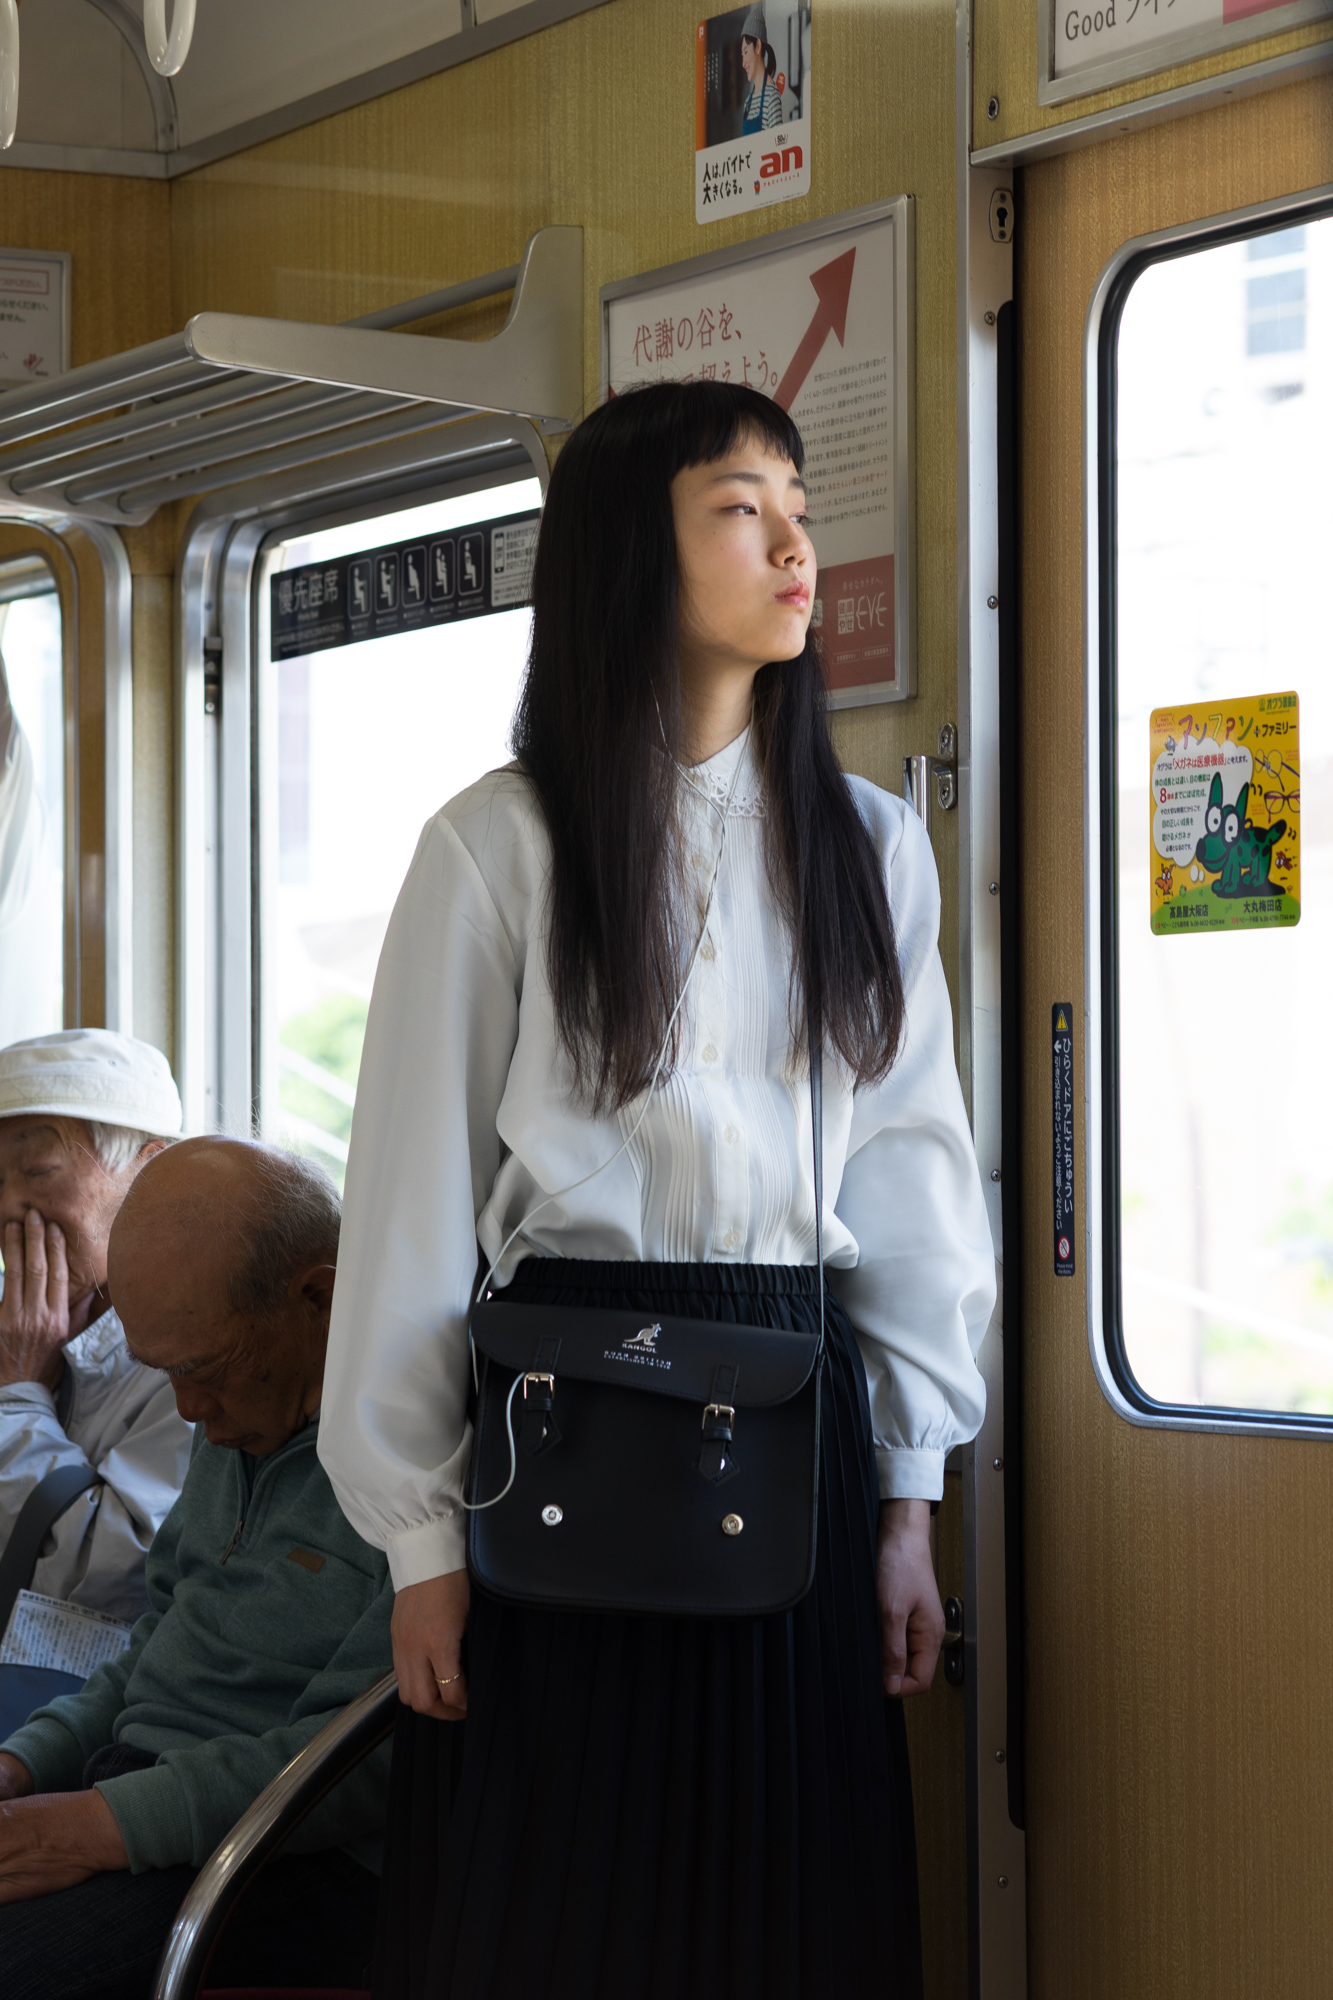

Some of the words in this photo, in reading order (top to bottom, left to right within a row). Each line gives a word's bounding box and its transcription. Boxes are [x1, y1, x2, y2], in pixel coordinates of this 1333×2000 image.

[1065, 0, 1116, 41] Good
[703, 151, 752, 183] 人は、バイトで
[759, 145, 803, 179] an
[702, 179, 743, 205] 大きくなる。
[632, 302, 742, 367] 代謝の谷を、
[278, 568, 338, 616] 優先座席
[856, 592, 888, 631] EVE
[1156, 753, 1248, 771] オグラは「メガネは医療機器」と考えます。
[1161, 817, 1194, 829] 目の正しい成長を
[1243, 898, 1283, 914] 大丸梅田店
[1062, 1038, 1073, 1214] ひらくドアにごちゅうい
[622, 1343, 657, 1354] KANGOL
